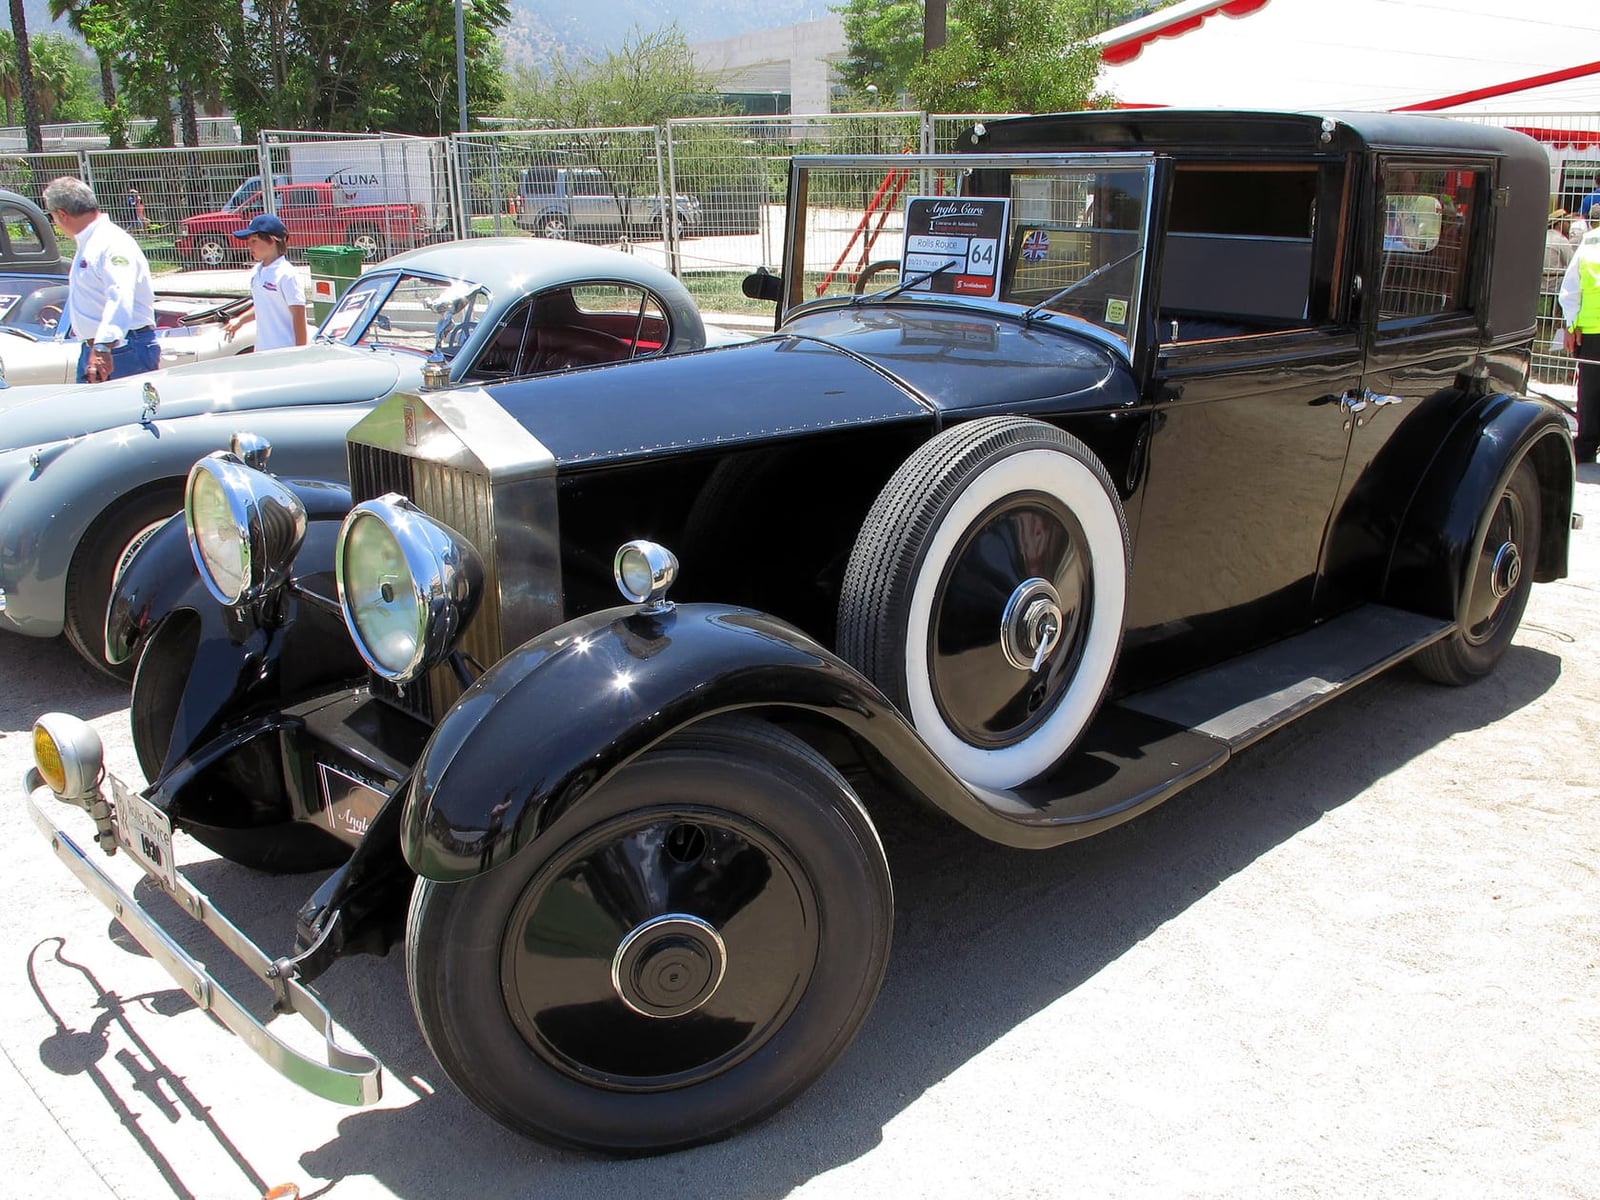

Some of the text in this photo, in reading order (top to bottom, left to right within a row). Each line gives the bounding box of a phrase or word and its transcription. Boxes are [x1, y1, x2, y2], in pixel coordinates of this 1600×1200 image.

[340, 174, 379, 185] LUNA
[925, 202, 984, 216] Anglo Cars
[917, 239, 958, 250] Rolls Royce
[971, 244, 993, 265] 64
